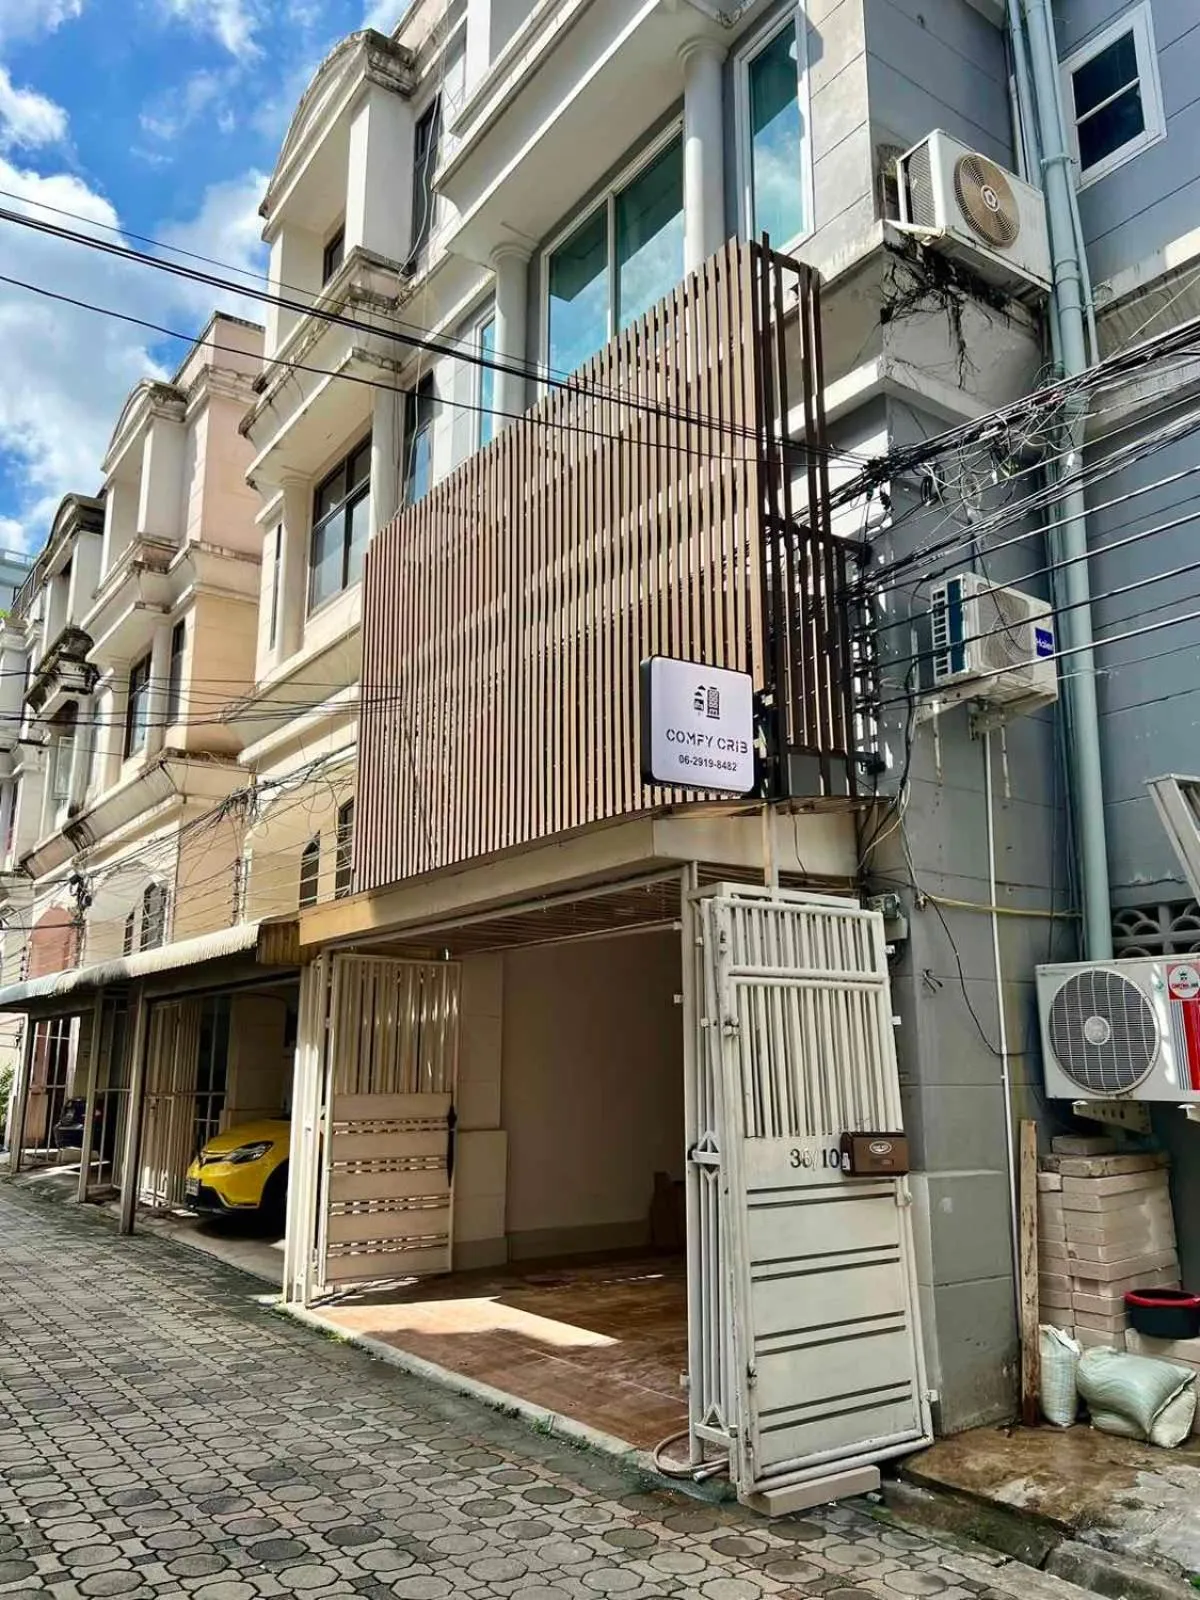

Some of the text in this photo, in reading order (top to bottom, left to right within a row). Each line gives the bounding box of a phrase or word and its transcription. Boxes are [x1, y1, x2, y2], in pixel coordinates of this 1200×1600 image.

[665, 728, 749, 754] COMFY CRIB
[678, 754, 738, 772] 06-2919-8482
